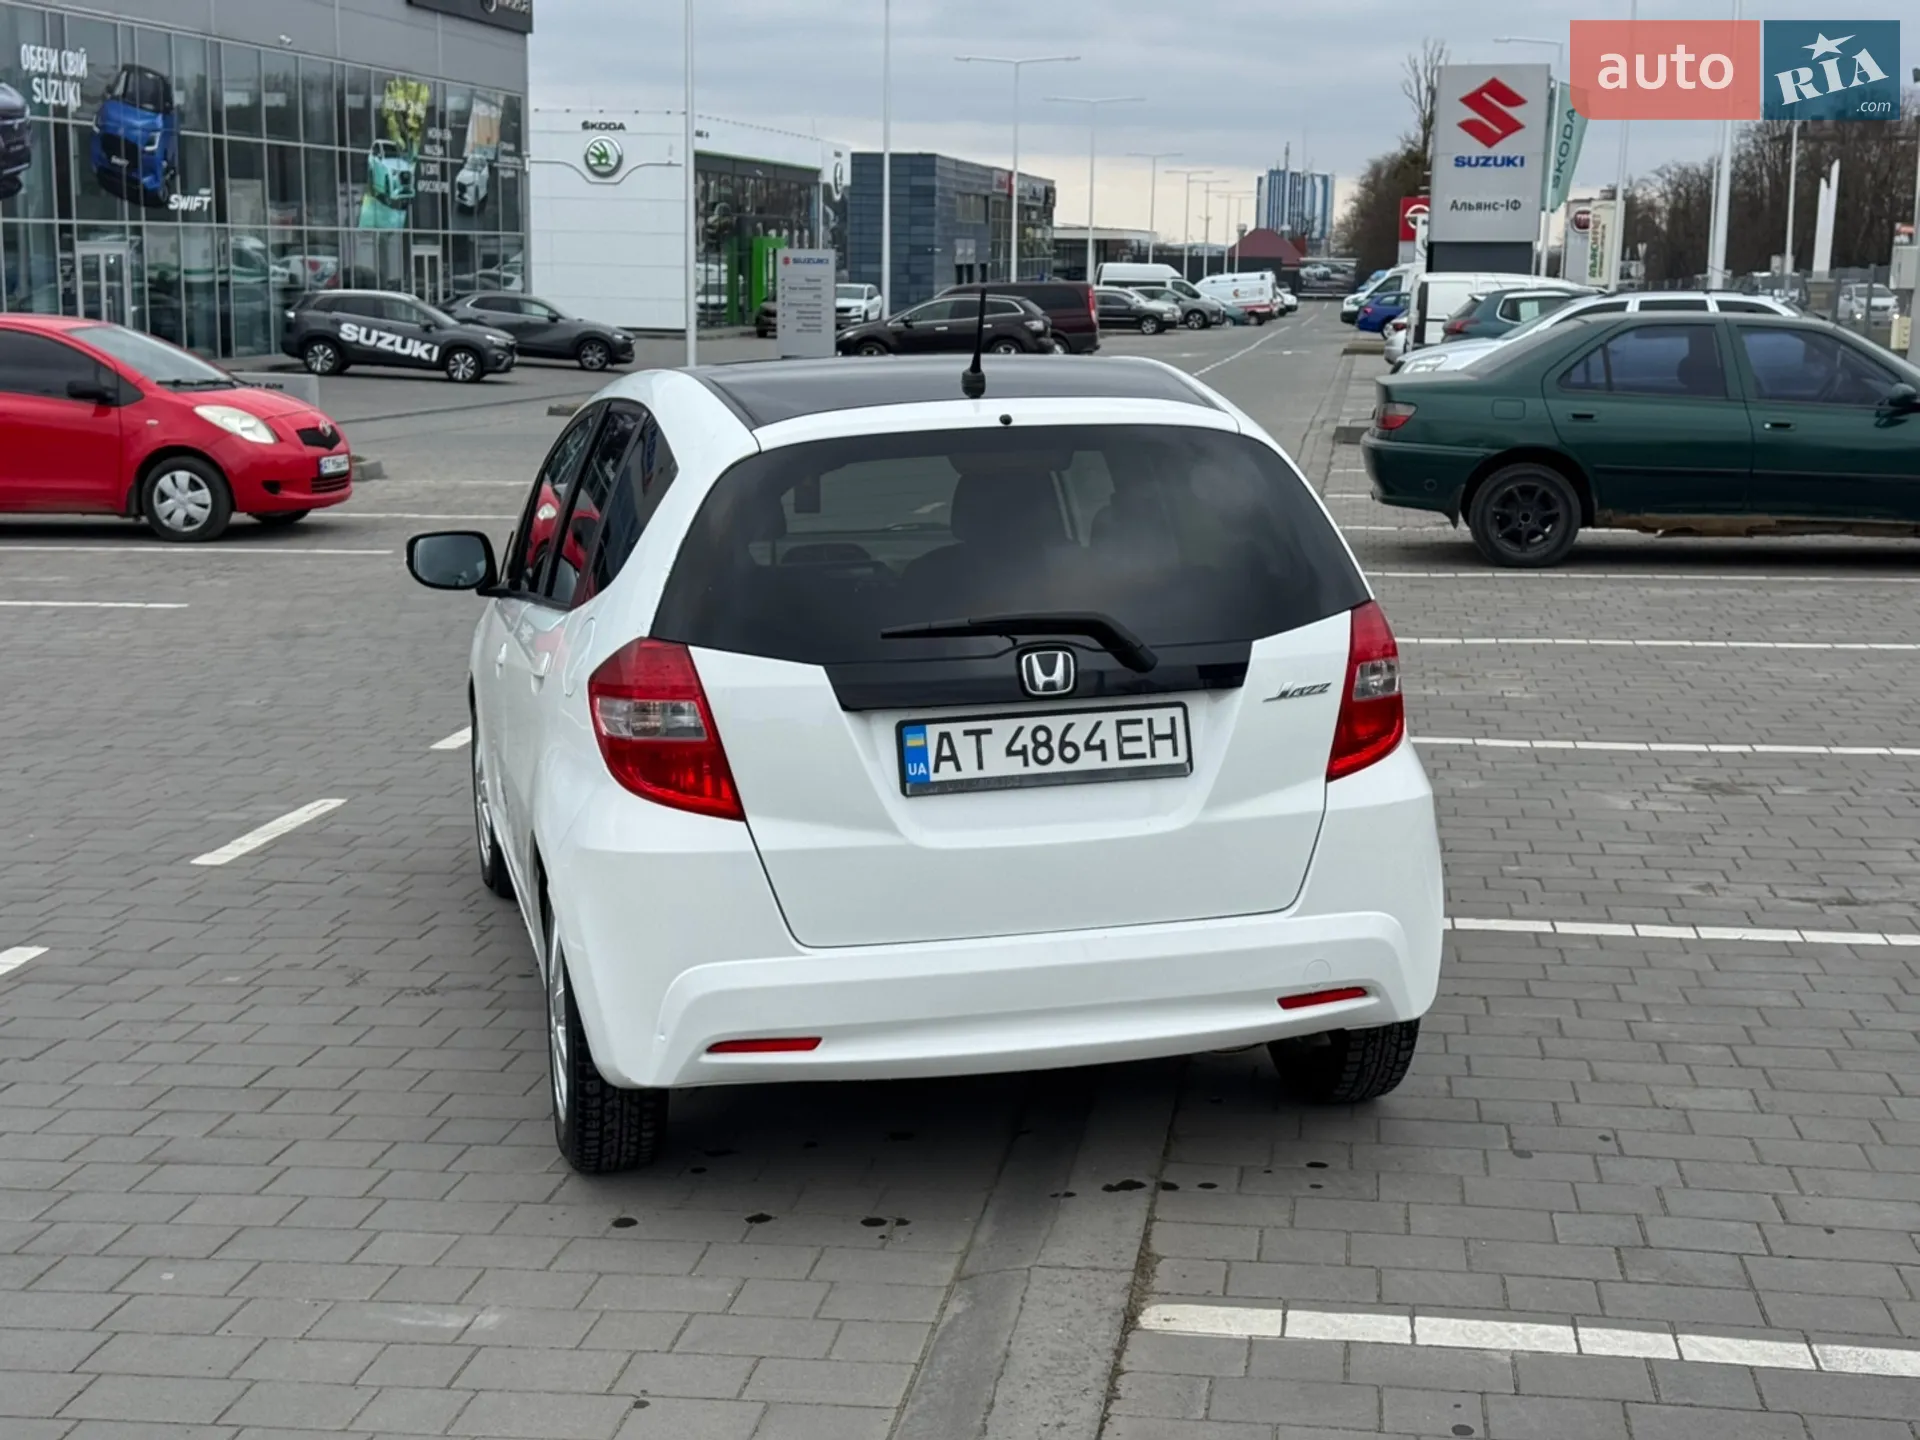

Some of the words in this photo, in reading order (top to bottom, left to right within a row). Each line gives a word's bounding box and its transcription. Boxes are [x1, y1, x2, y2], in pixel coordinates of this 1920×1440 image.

[21, 43, 59, 74] ОБЕРИ
[32, 77, 81, 109] SUZUKI
[581, 120, 626, 131] ŠKODA
[1453, 155, 1525, 168] SUZUKI
[168, 194, 211, 211] SWIFT
[1449, 199, 1522, 212] Альянс-ІФ
[339, 322, 440, 362] SUZUKI
[932, 728, 993, 775] AT
[908, 761, 927, 776] UA
